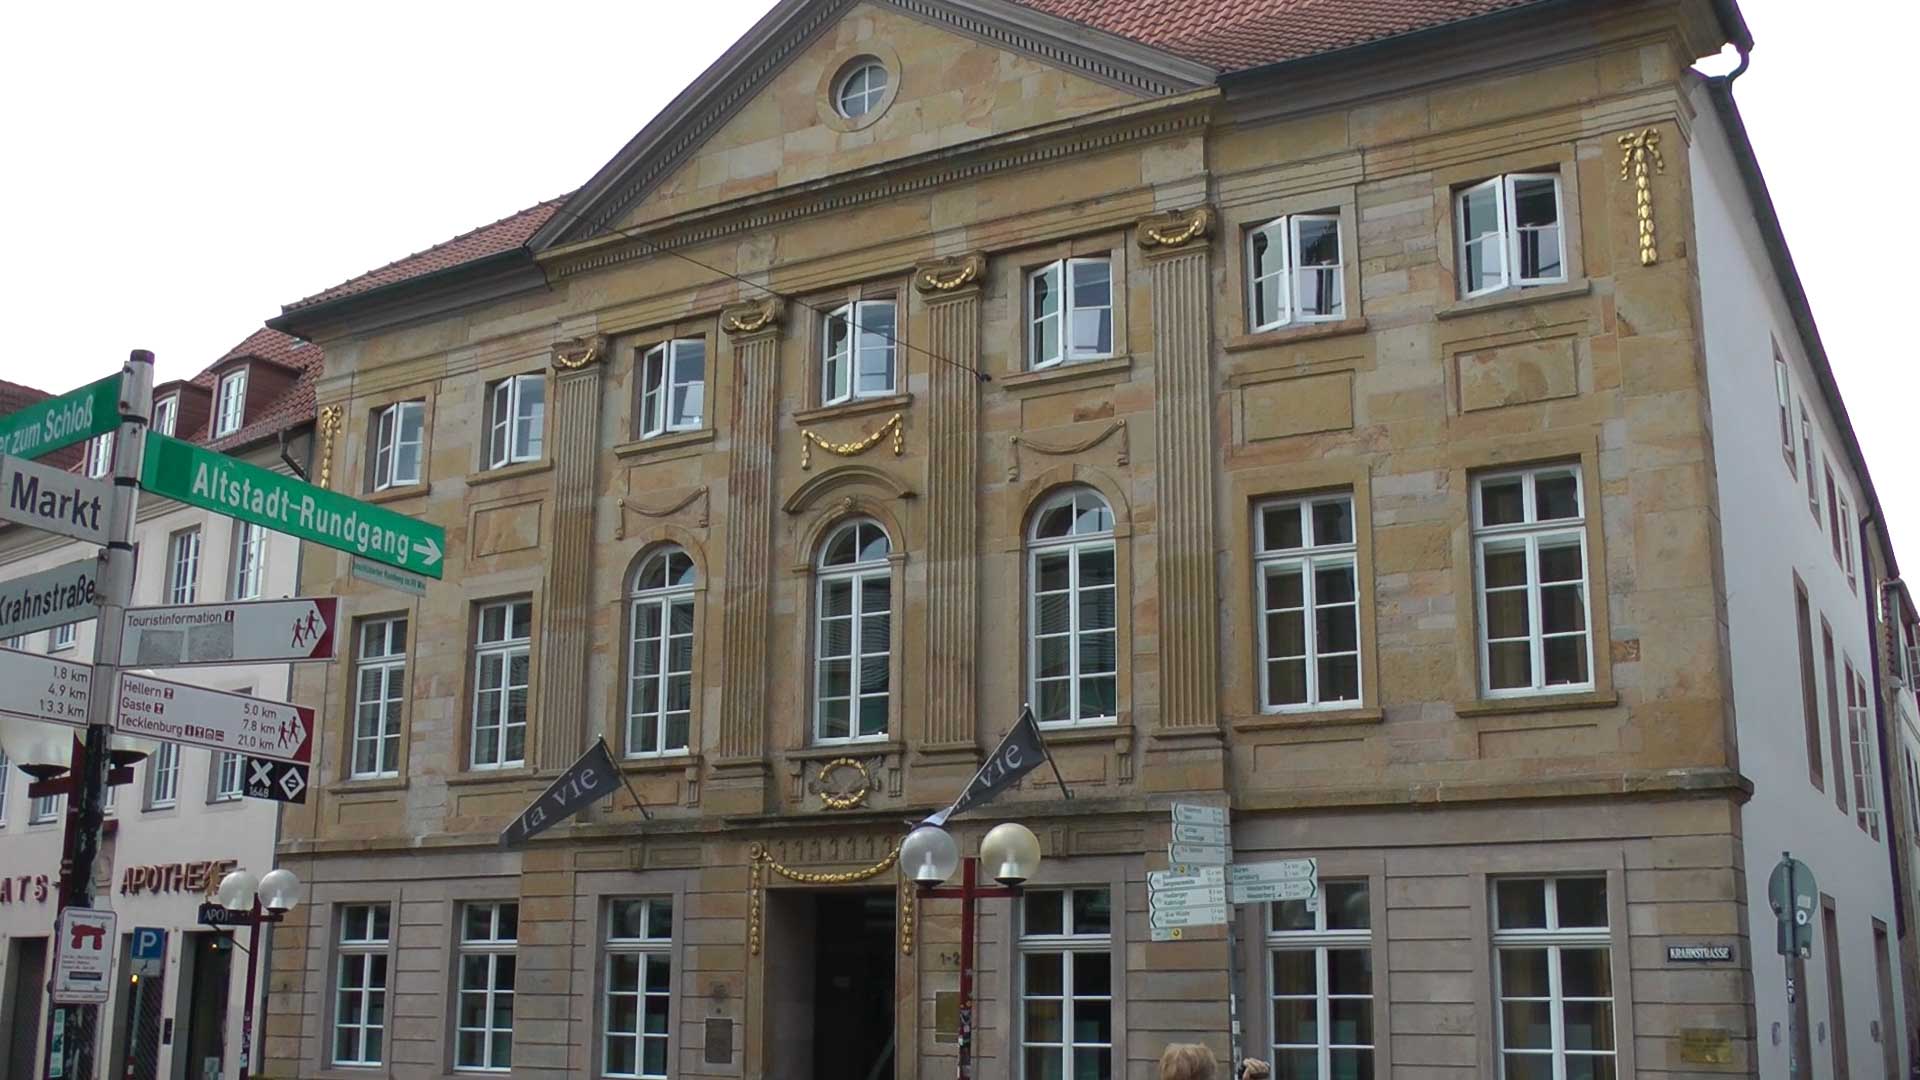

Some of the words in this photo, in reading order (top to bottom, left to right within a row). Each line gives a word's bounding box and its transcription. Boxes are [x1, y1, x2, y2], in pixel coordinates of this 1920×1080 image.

[11, 422, 41, 455] zum
[43, 394, 94, 443] Schloß
[10, 471, 102, 531] Markt
[191, 462, 410, 564] Altstadt-Rundgang
[127, 611, 223, 627] Touristinformation
[69, 686, 87, 701] km
[71, 668, 88, 684] km
[67, 703, 85, 718] km
[121, 696, 152, 713] Gaste
[260, 723, 276, 736] km
[123, 679, 161, 697] Hellern
[261, 706, 277, 720] km
[120, 712, 183, 738] Tecklenburg
[259, 738, 275, 752] km
[521, 804, 547, 835] la
[551, 768, 598, 807] vie
[138, 930, 157, 957] P
[1669, 947, 1730, 960] KRAHNSTRASSE
